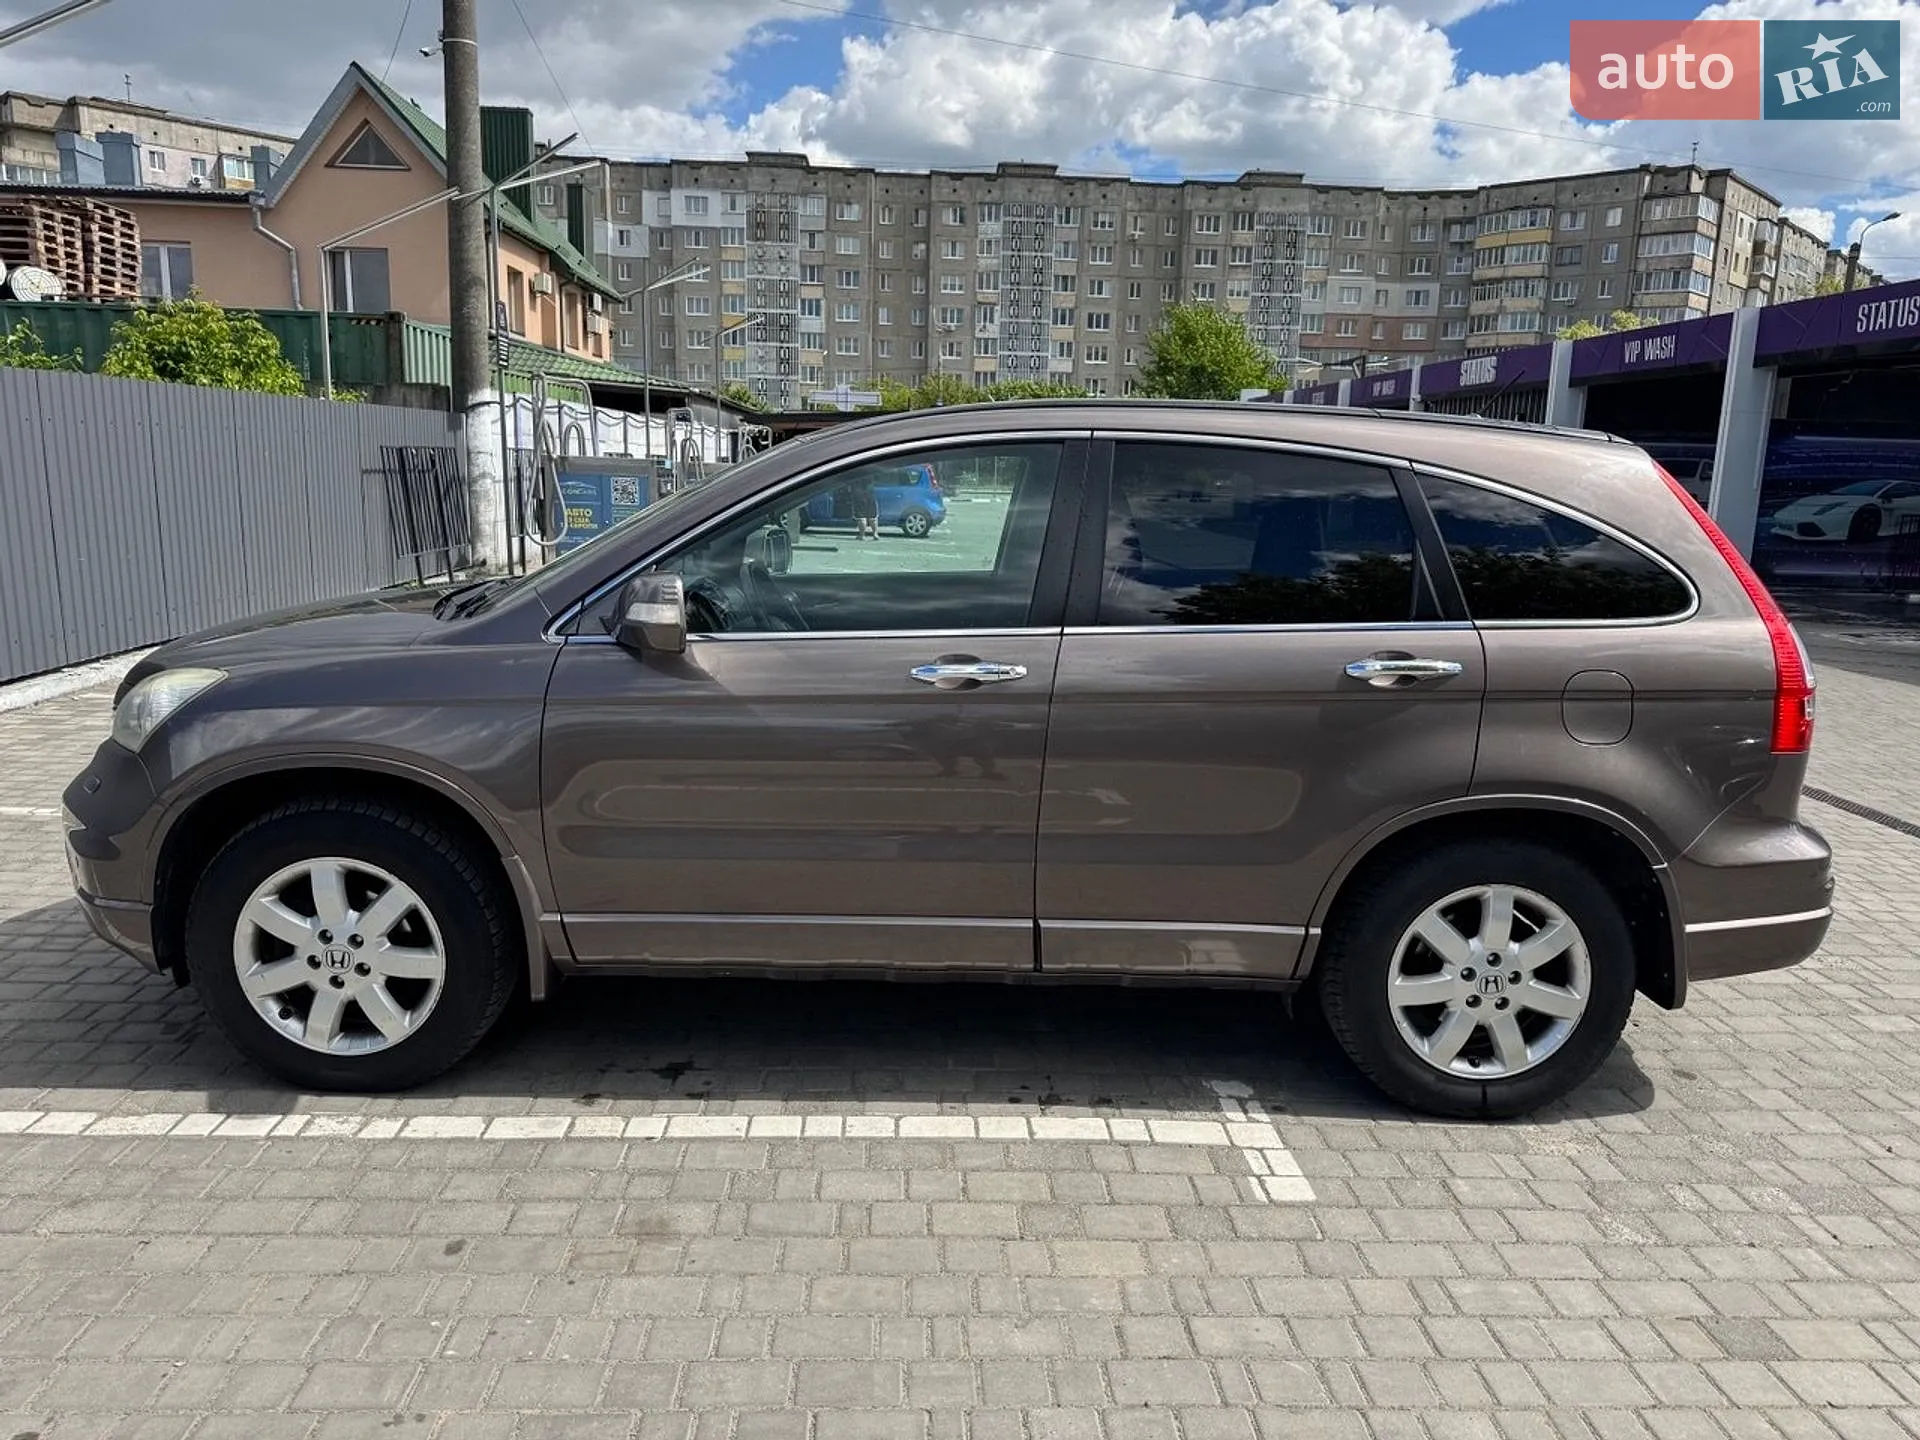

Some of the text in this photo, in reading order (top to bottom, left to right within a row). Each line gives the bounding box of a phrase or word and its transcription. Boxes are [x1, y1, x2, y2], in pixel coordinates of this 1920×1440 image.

[1857, 295, 1920, 333] STATUS
[1624, 335, 1676, 363] VIP WASH
[1459, 355, 1497, 387] STATUS
